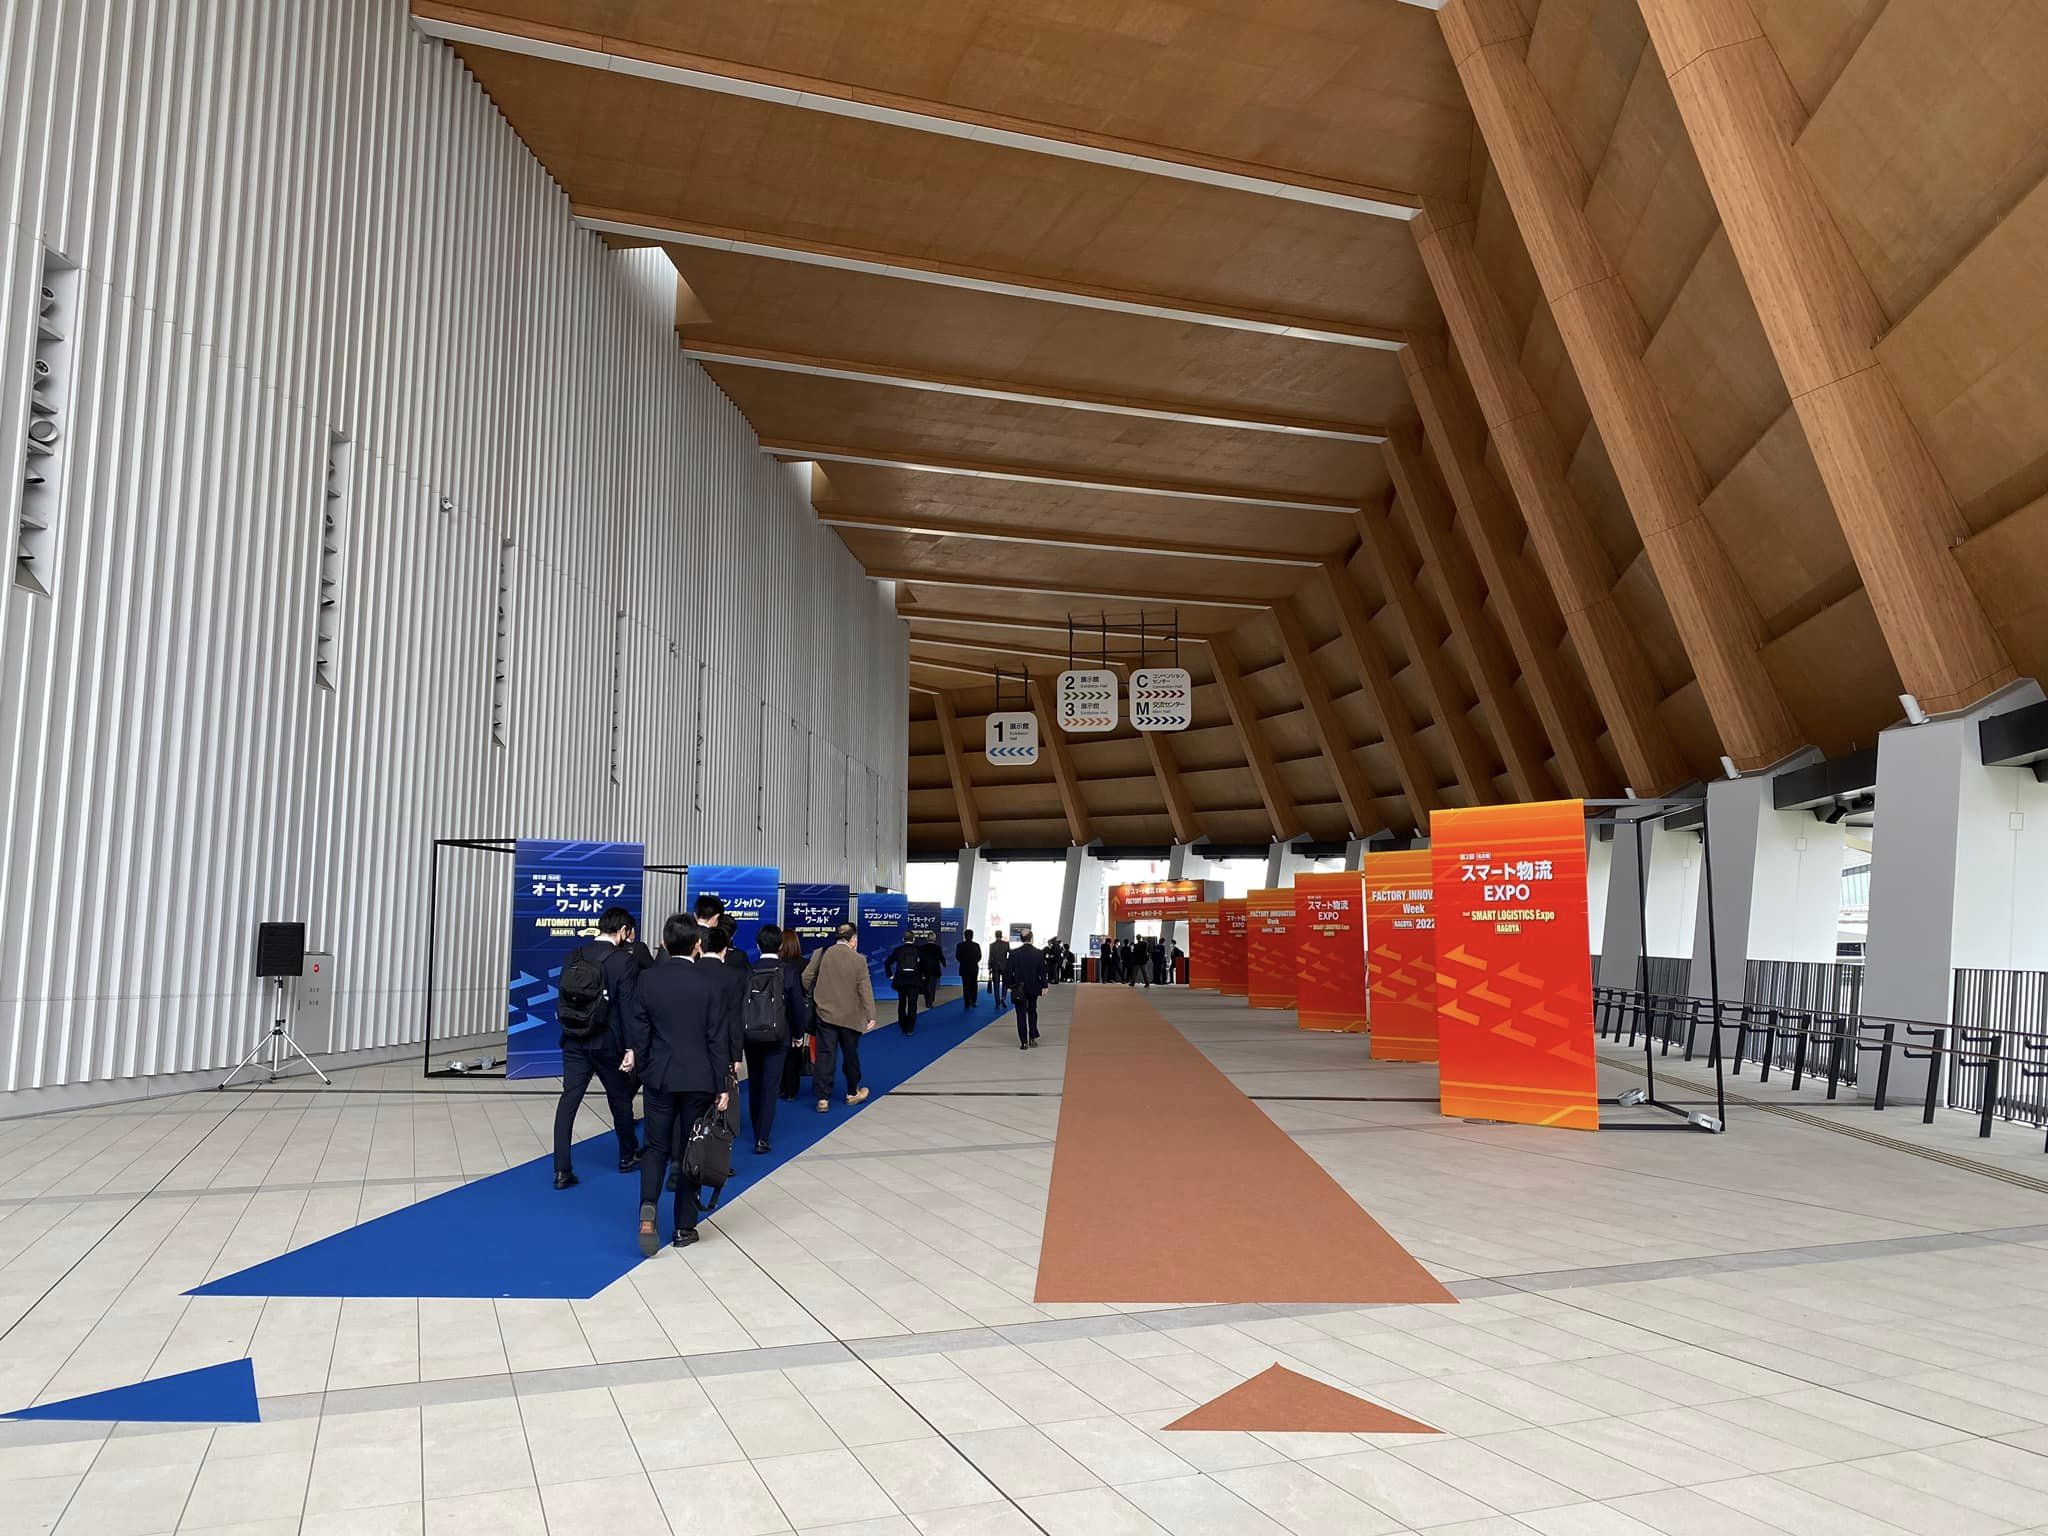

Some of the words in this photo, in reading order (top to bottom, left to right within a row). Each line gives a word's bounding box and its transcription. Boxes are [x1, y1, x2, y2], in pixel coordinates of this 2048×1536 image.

[1065, 676, 1075, 690] 2
[1136, 674, 1148, 688] C
[1065, 702, 1075, 717] 3
[1136, 701, 1149, 715] M
[993, 721, 1003, 742] 1
[1461, 860, 1553, 882] スマート物流
[532, 882, 626, 898] オートモーティブ
[1372, 890, 1406, 902] FACTORY
[1483, 884, 1530, 902] EXPO
[556, 899, 604, 913] ワールド
[734, 898, 766, 909] ジャパン
[1307, 900, 1349, 910] スマート物流
[1402, 903, 1426, 914] Week
[793, 906, 841, 916] オートモーティブ
[1318, 912, 1339, 920] EXPO
[1471, 910, 1497, 921] SMART
[1497, 910, 1535, 920] LOGISTICS
[1535, 909, 1555, 922] Expo
[535, 918, 587, 927] AUTOMOTIVE
[805, 916, 830, 924] ワールド
[1495, 923, 1520, 933] NAGOYA
